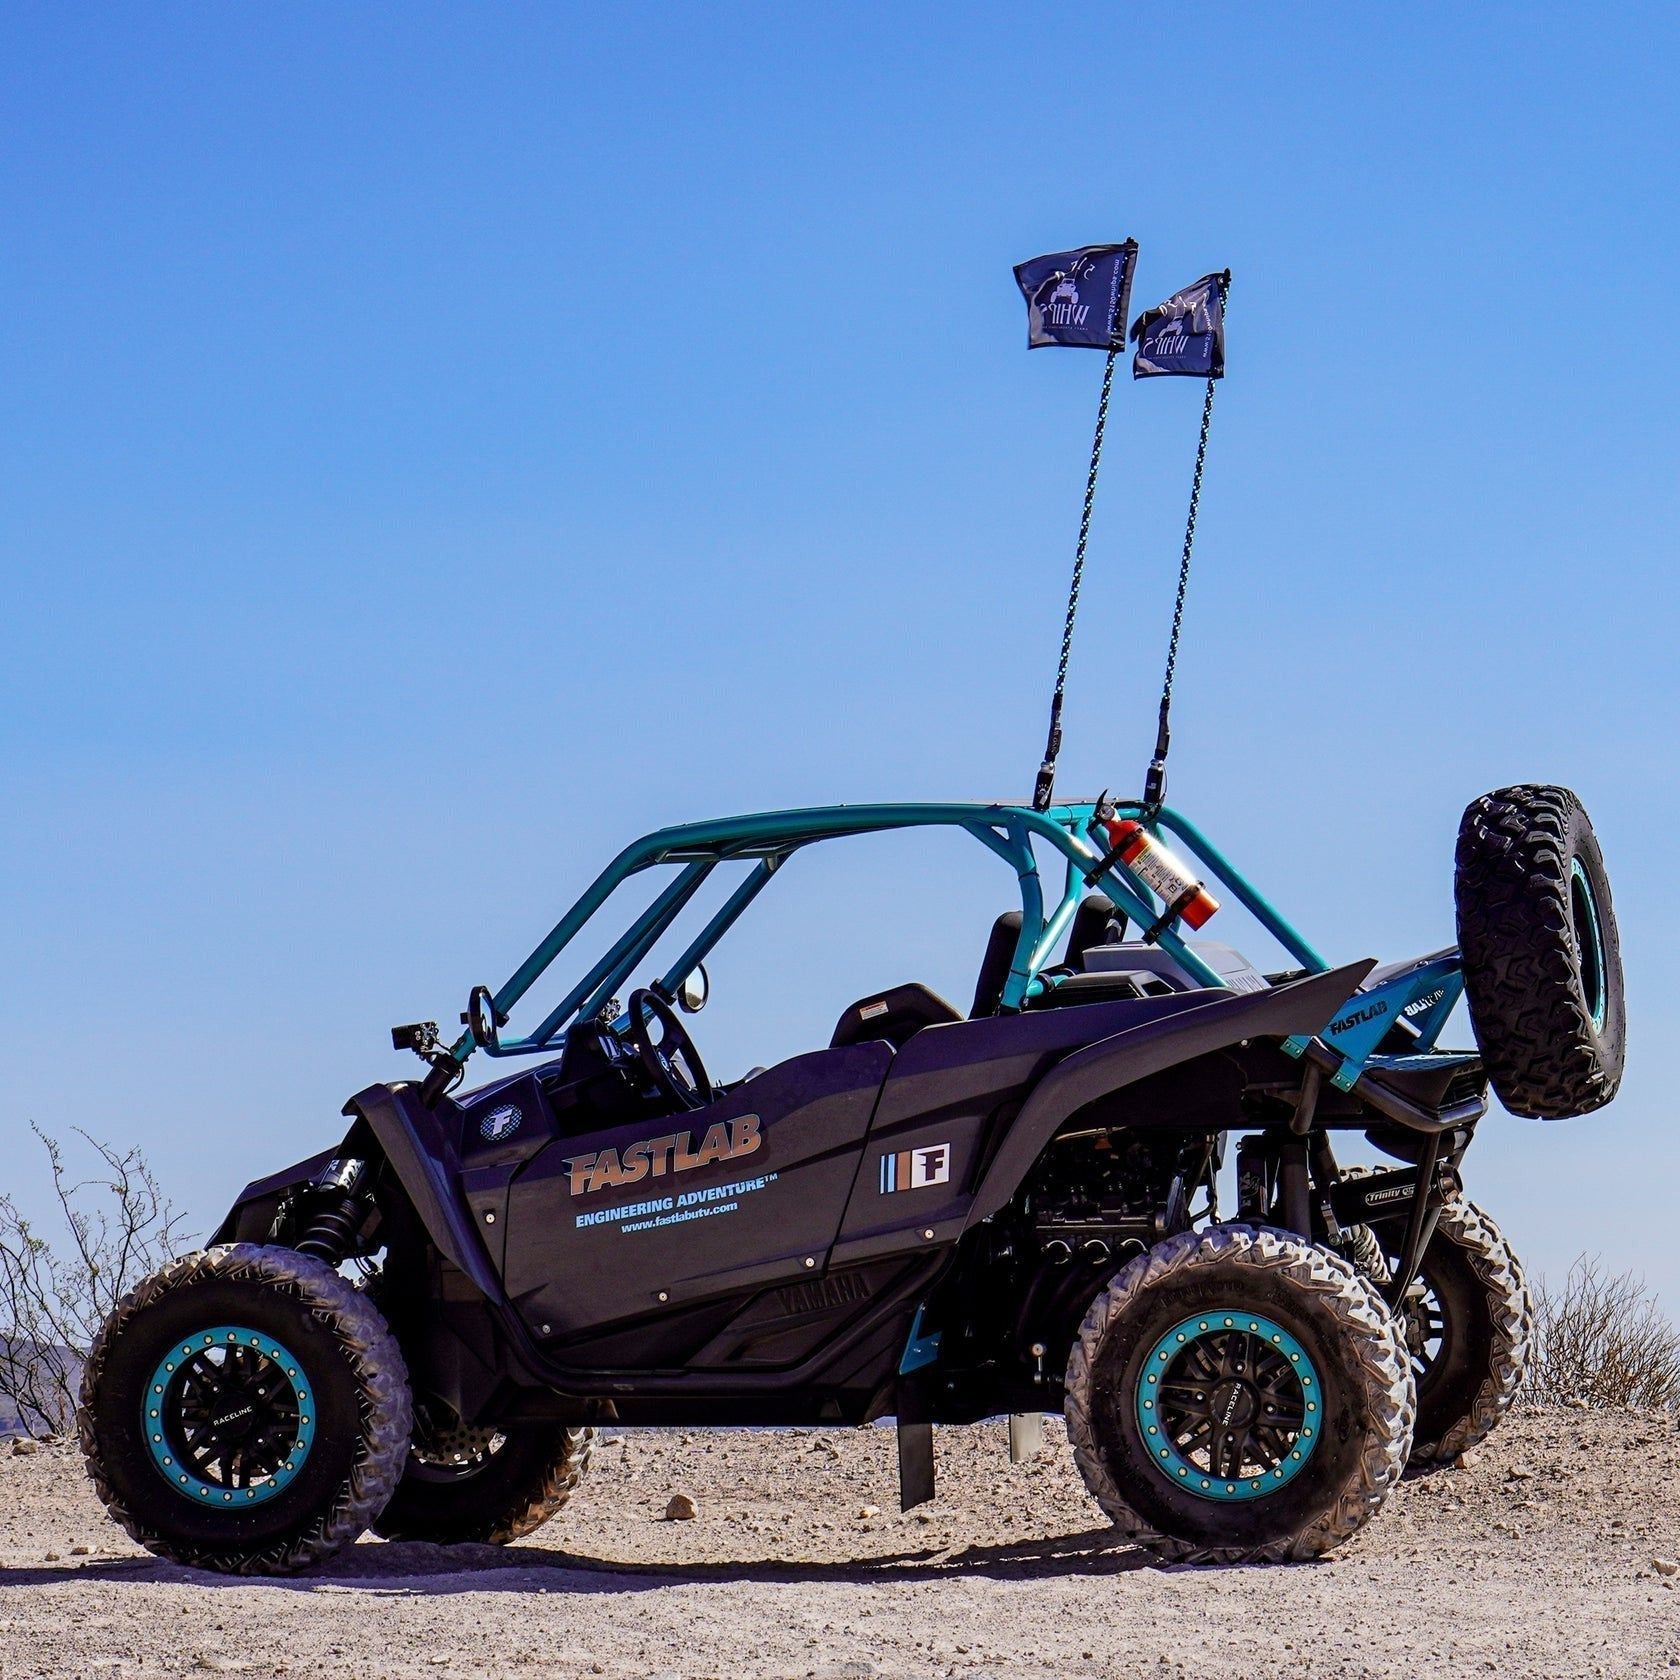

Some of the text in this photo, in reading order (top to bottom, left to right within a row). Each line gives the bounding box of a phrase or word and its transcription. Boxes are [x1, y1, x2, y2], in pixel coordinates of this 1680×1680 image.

[1328, 1000, 1388, 1036] FASTLAB
[490, 1109, 513, 1135] F
[561, 1113, 762, 1196] FASTLAB
[917, 1149, 945, 1182] F
[1367, 1188, 1401, 1202] Trinity
[575, 1197, 674, 1229] ENGINEERING
[621, 1201, 738, 1234] www.fastlabutv.com
[775, 1272, 873, 1314] YAMAHA
[213, 1405, 253, 1427] RACELINE
[1222, 1382, 1242, 1427] RACELINE
